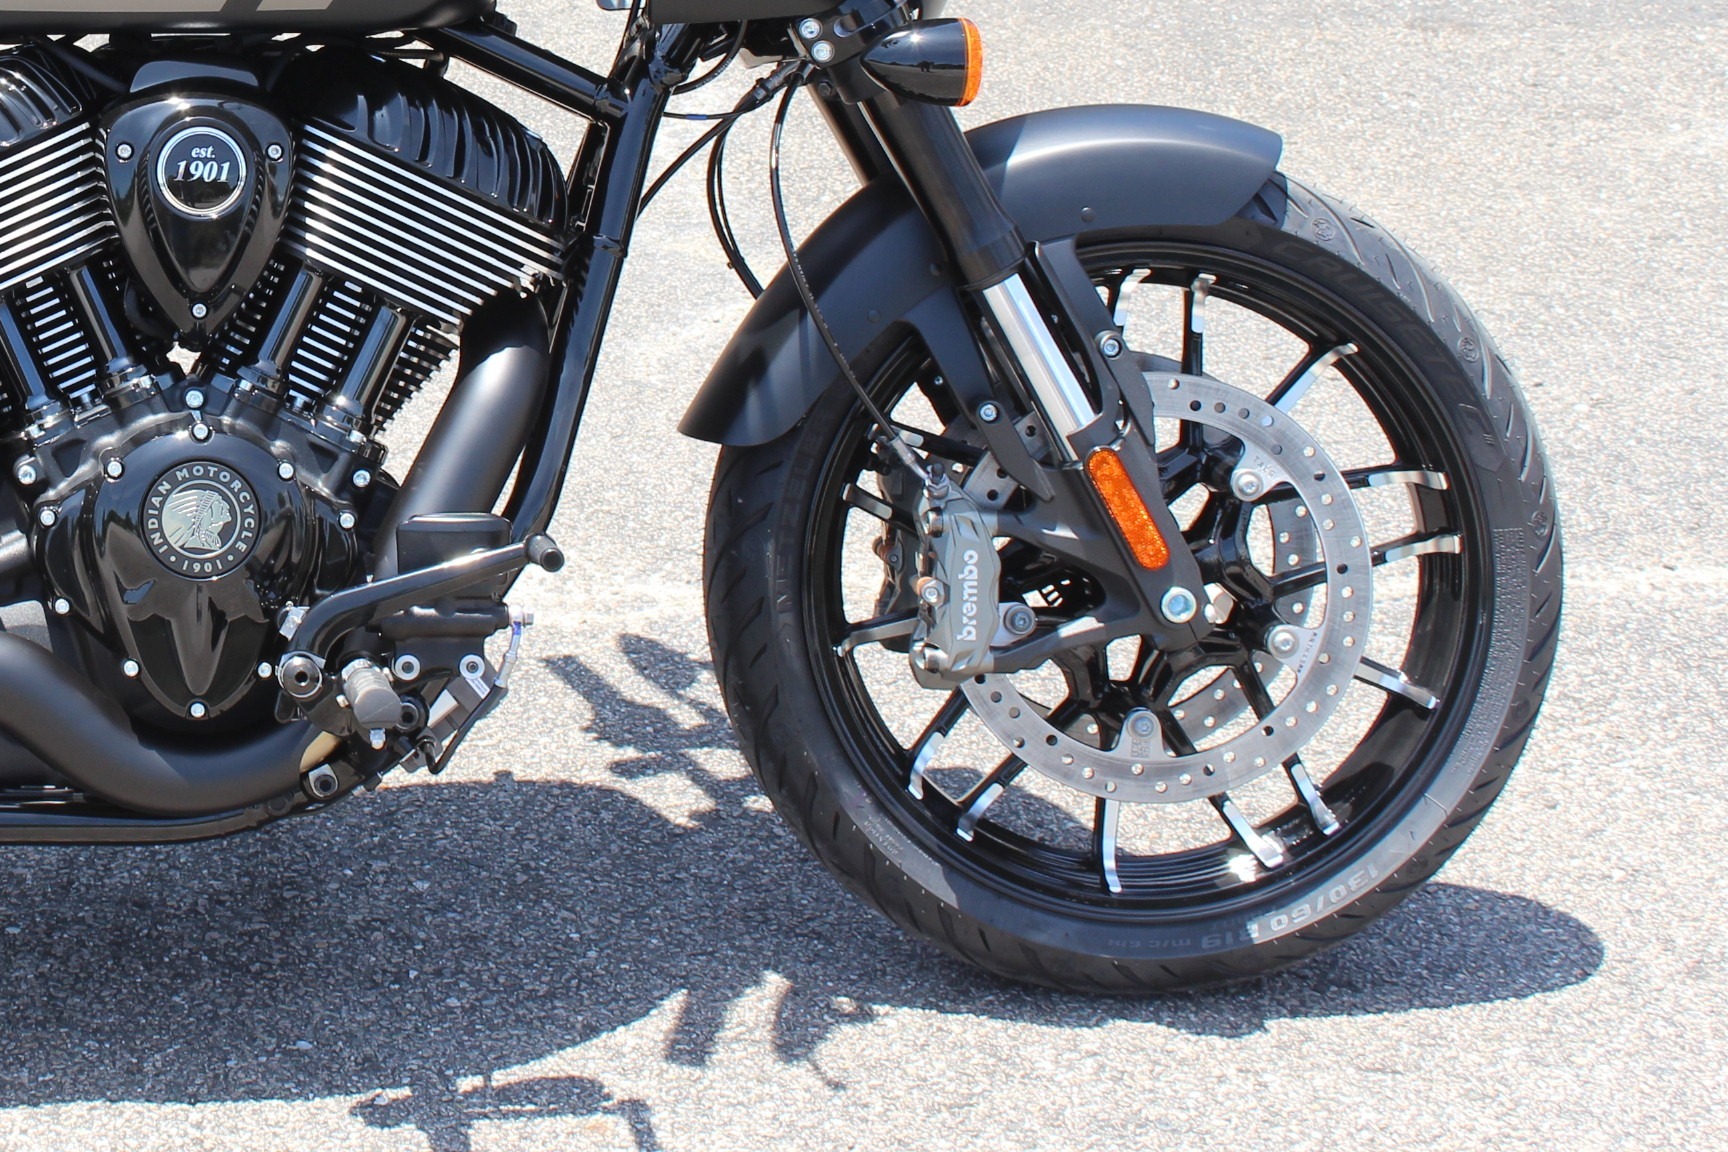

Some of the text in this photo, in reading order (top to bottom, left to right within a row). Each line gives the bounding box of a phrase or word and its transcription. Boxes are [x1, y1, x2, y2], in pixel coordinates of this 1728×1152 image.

[173, 160, 231, 183] 1901
[191, 145, 216, 159] est.
[148, 466, 255, 553] INDIAN MOTORCYCLE
[182, 559, 223, 573] 1901
[957, 549, 979, 641] brembo
[1270, 864, 1381, 932] 130/60
